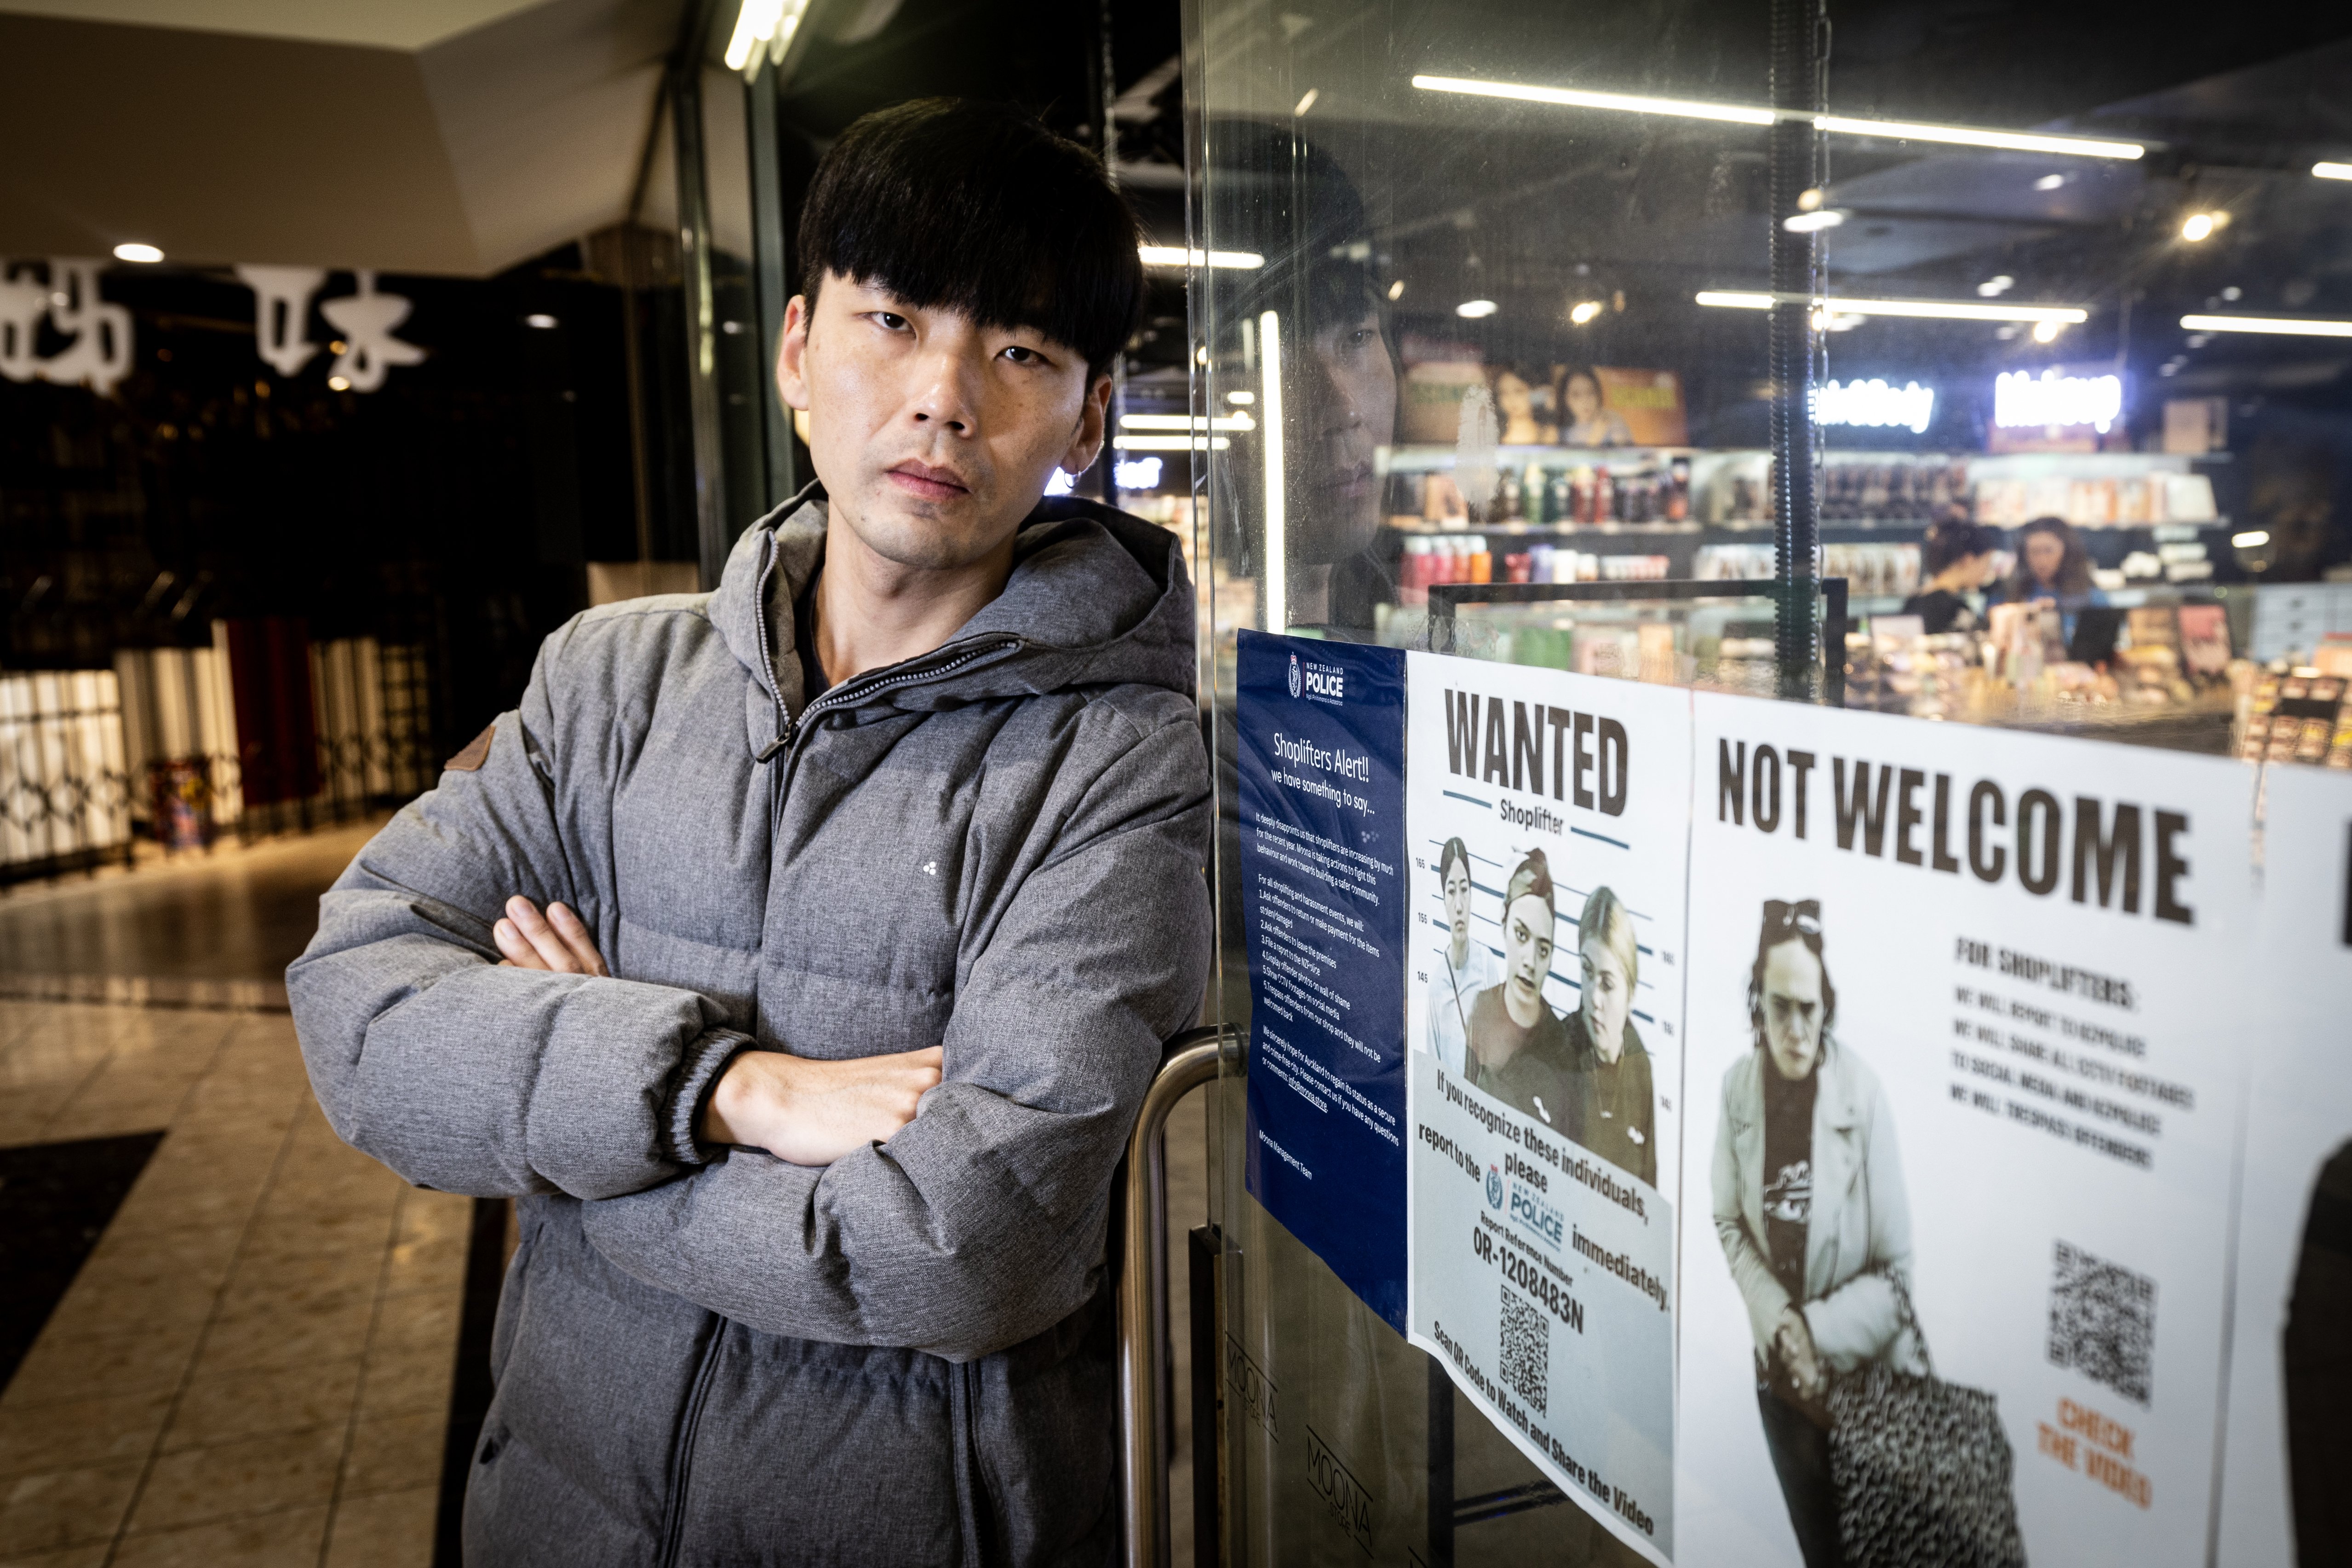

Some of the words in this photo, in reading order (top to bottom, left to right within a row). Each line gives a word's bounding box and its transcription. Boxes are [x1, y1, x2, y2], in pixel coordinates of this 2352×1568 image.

[1306, 672, 1343, 697] POLICE
[1319, 664, 1343, 675] ZEALAND
[1274, 733, 1331, 771] Shoplifters
[1334, 749, 1369, 783] Alert!!
[1445, 688, 1629, 818] WANTED
[1271, 770, 1282, 783] we
[1284, 767, 1301, 789] have
[1302, 780, 1341, 808] something
[1343, 789, 1352, 806] to
[1354, 796, 1375, 816] say...
[1500, 798, 1564, 836] Shoplifter
[1256, 812, 1260, 821] It
[1261, 814, 1275, 829] deeply
[1276, 819, 1299, 837] disappoints
[1306, 831, 1314, 843] that
[1315, 835, 1339, 852] shoplifters
[1349, 847, 1373, 869] increasing
[1374, 857, 1380, 872] by
[1381, 862, 1394, 876] much
[1718, 736, 1817, 841] NOT
[1833, 754, 2196, 928] WELCOME
[1257, 843, 1279, 859] behaviour
[1288, 856, 1298, 868] work
[1298, 861, 1315, 876] towards
[1316, 867, 1334, 886] building
[1338, 879, 1351, 891] safer
[1351, 885, 1380, 906] community.
[1273, 835, 1286, 847] recent
[1286, 840, 1296, 851] year.
[1297, 843, 1311, 858] Moona
[1312, 849, 1315, 860] is
[1316, 852, 1330, 868] taking
[1331, 859, 1348, 873] actions
[1348, 865, 1354, 875] to
[1354, 867, 1366, 881] fight
[1367, 873, 1376, 885] this
[1416, 856, 1425, 869] 165
[1259, 890, 1271, 902] 1.Ask
[1272, 895, 1291, 912] offenders
[1291, 905, 1296, 914] to
[1296, 908, 1309, 921] return
[1315, 919, 1327, 930] make
[1328, 925, 1348, 937] payment
[1366, 941, 1379, 958] items
[1274, 880, 1294, 900] shoplifting
[1303, 894, 1328, 915] harassment
[1329, 909, 1346, 925] events,
[1347, 917, 1353, 927] we
[1354, 920, 1364, 932] will:
[1417, 912, 1427, 924] 155
[1261, 920, 1273, 933] 2.Ask
[1273, 926, 1291, 943] offenders
[1292, 936, 1296, 946] to
[1297, 938, 1308, 953] leave
[1316, 952, 1337, 969] premises
[1262, 950, 1280, 969] 4.Display
[1281, 961, 1297, 978] offender
[1298, 972, 1313, 988] photos
[1313, 982, 1319, 991] on
[1319, 986, 1329, 998] wall
[1329, 991, 1334, 1000] of
[1335, 994, 1350, 1010] shame
[1417, 971, 1428, 983] 145
[1263, 1025, 1269, 1037] We
[1270, 1030, 1287, 1051] sincerely
[1288, 1041, 1297, 1057] hope
[1305, 1055, 1324, 1076] Auckland
[1325, 1069, 1330, 1080] to
[1331, 1074, 1344, 1091] regain
[1352, 1089, 1367, 1106] status
[1367, 1100, 1373, 1110] as
[1374, 1105, 1377, 1114] a
[1378, 1108, 1395, 1126] secure
[1270, 1048, 1291, 1068] crime-free
[1291, 1062, 1300, 1075] city.
[1300, 1067, 1314, 1085] Please
[1314, 1080, 1331, 1098] contact
[1332, 1092, 1337, 1102] us
[1338, 1094, 1342, 1104] if
[1342, 1099, 1351, 1112] you
[1352, 1103, 1364, 1120] have
[1365, 1115, 1373, 1130] any
[1374, 1122, 1399, 1146] questions
[1259, 1129, 1273, 1148] Moona
[1274, 1141, 1300, 1170] Management
[1300, 1162, 1312, 1180] Team
[1419, 1123, 1454, 1159] report
[1455, 1147, 1464, 1169] to
[1465, 1152, 1480, 1183] the
[1437, 1068, 1445, 1093] If
[1446, 1077, 1463, 1105] you
[1463, 1092, 1520, 1144] recognize
[1524, 1126, 1559, 1168] these
[1561, 1147, 1649, 1227] individuals,
[1504, 1152, 1548, 1194] please
[1509, 1192, 1564, 1244] POLICE
[1572, 1223, 1671, 1313] immediately.
[1434, 1320, 1453, 1355] Scan
[1453, 1341, 1464, 1368] QR
[1464, 1355, 1485, 1391] Code
[1486, 1378, 1496, 1398] to
[1497, 1388, 1528, 1433] Watch
[1530, 1420, 1550, 1452] and
[1552, 1438, 1586, 1485] Share
[1588, 1469, 1610, 1504] the
[1613, 1485, 1654, 1537] Video
[1307, 1435, 1372, 1547] MOONA
